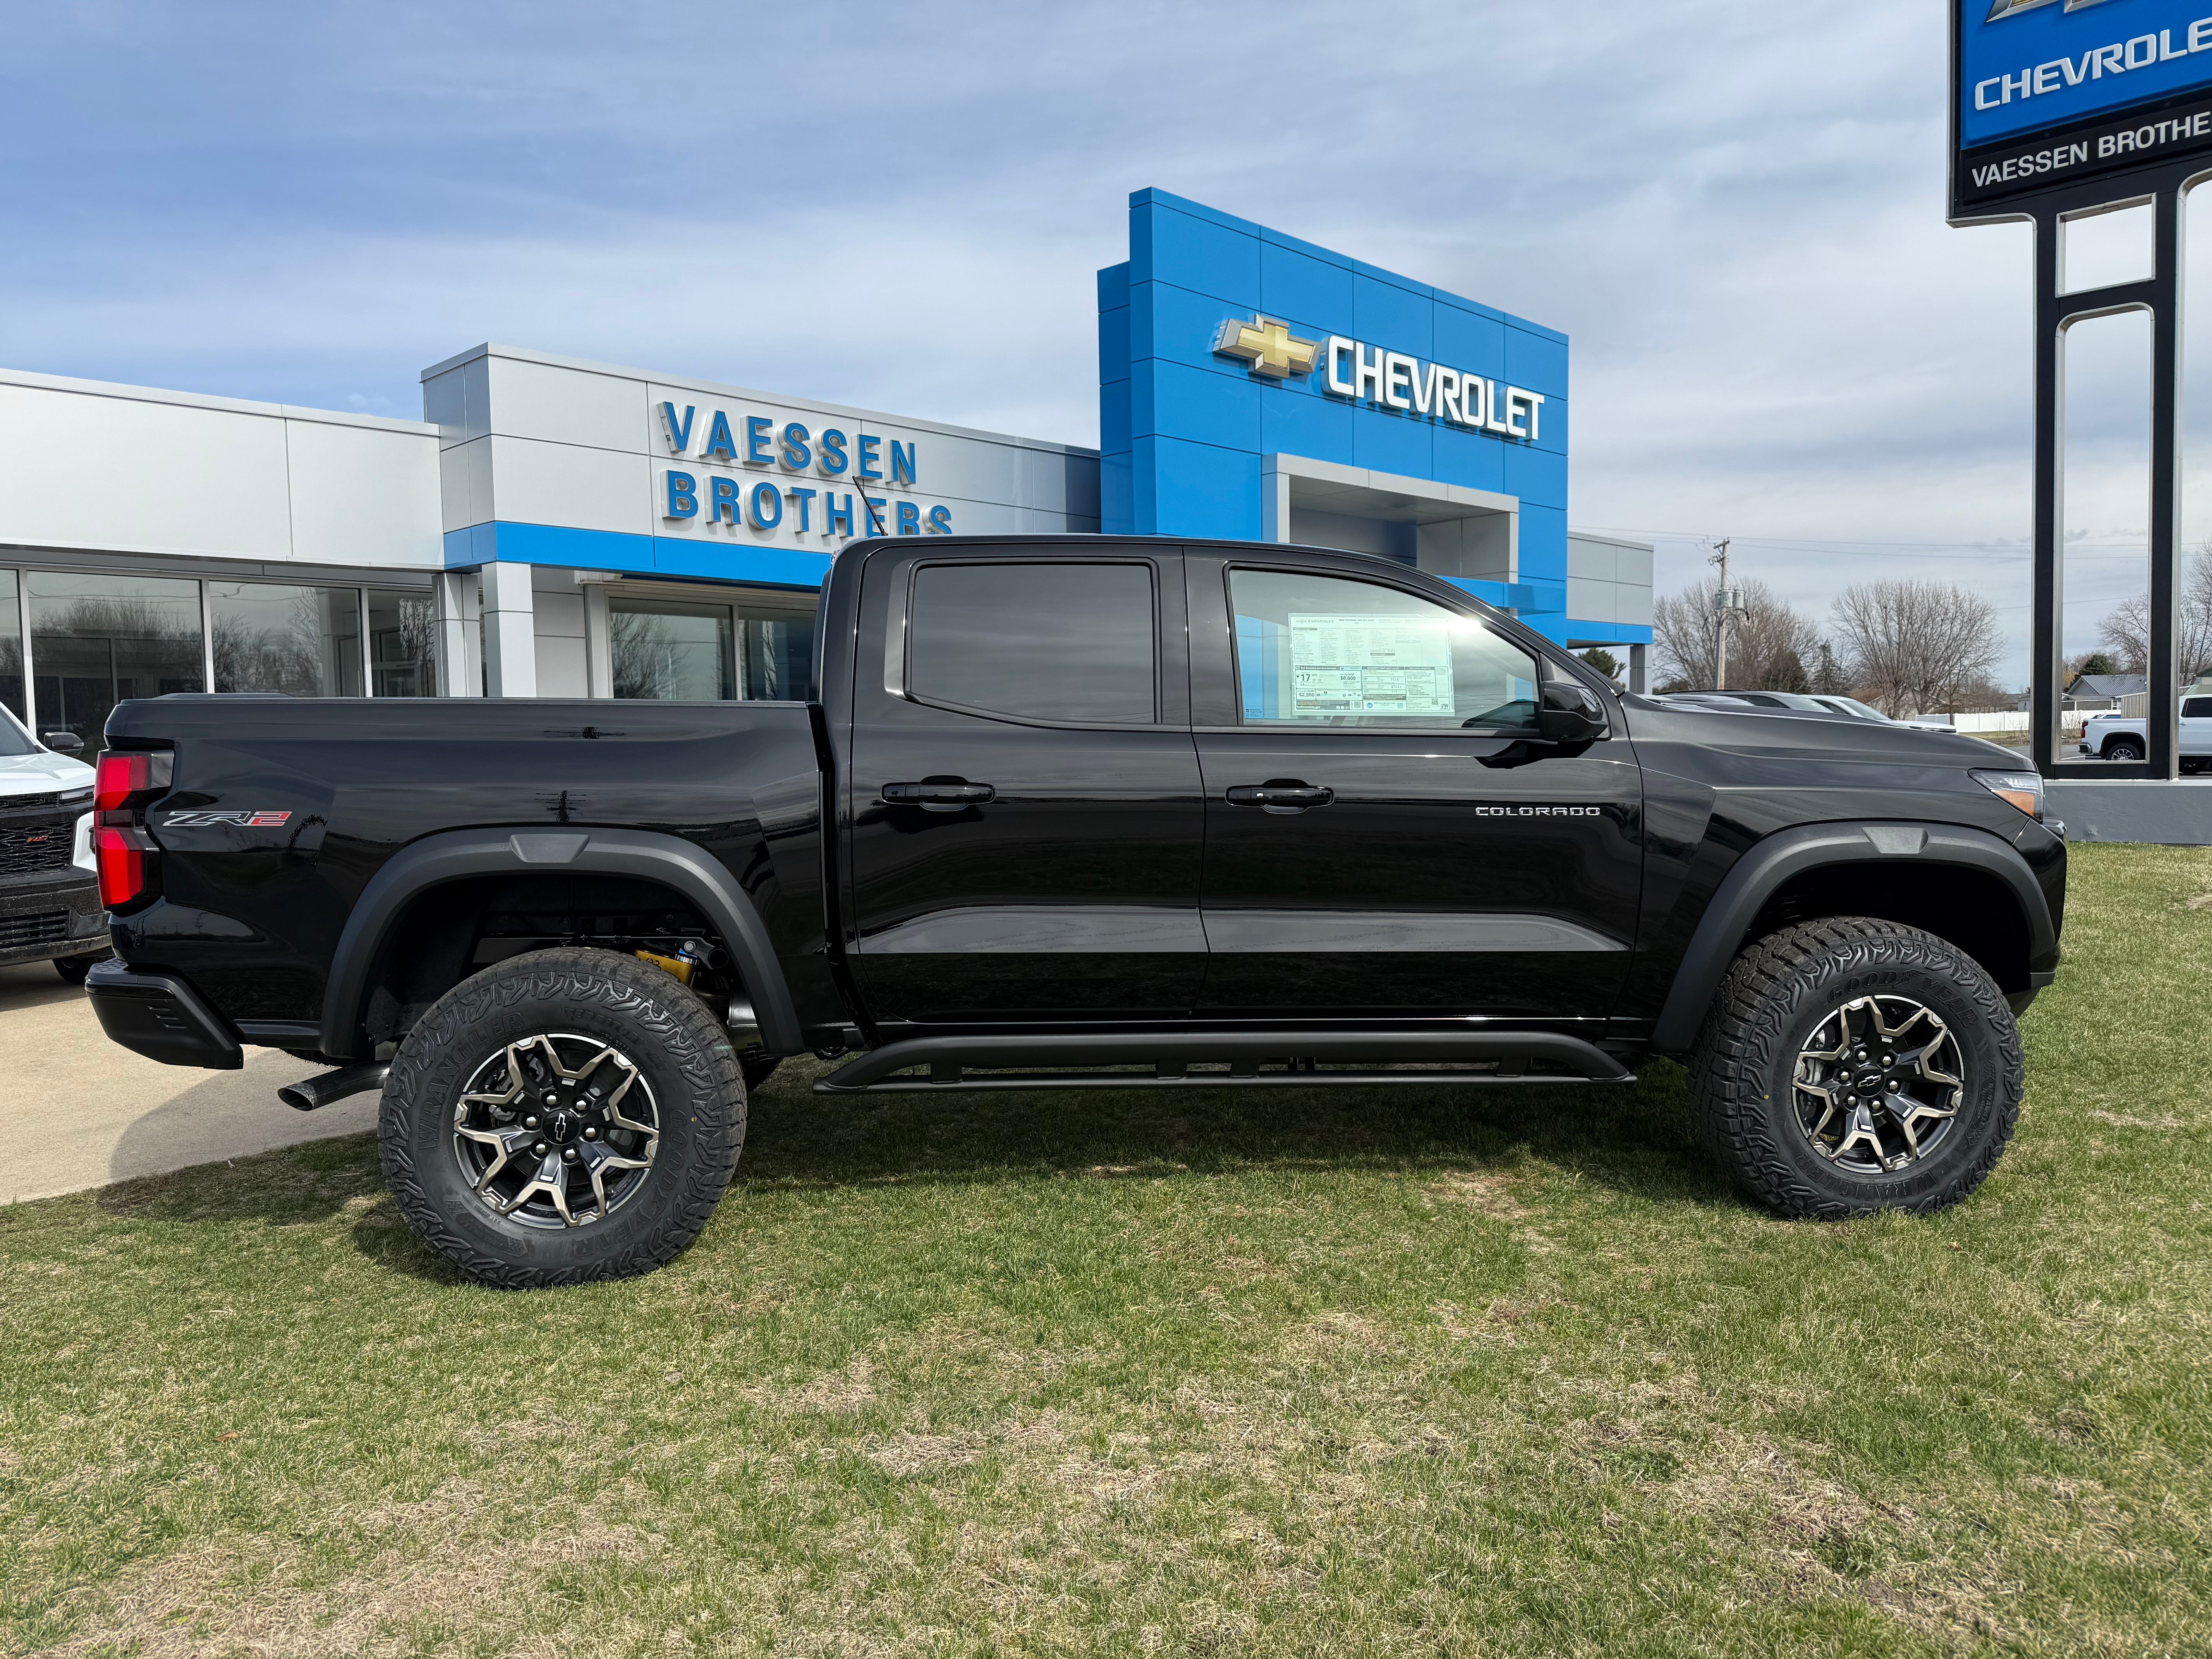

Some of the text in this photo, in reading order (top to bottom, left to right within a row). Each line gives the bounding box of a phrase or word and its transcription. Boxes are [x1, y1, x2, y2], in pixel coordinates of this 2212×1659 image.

[1975, 17, 2212, 111] CHEVROLE
[1972, 111, 2211, 188] VAESSEN BROTHE
[1322, 335, 1544, 440] CHEVROLET
[657, 401, 916, 485] VAESSEN
[660, 470, 952, 537] BROTHERS
[162, 811, 293, 827] ZR2
[1475, 807, 1601, 816] COLORADO
[1827, 969, 1978, 1027] GOODYEAR
[418, 1012, 524, 1150] WRANGLER
[1795, 1152, 1937, 1202] WRANGLER
